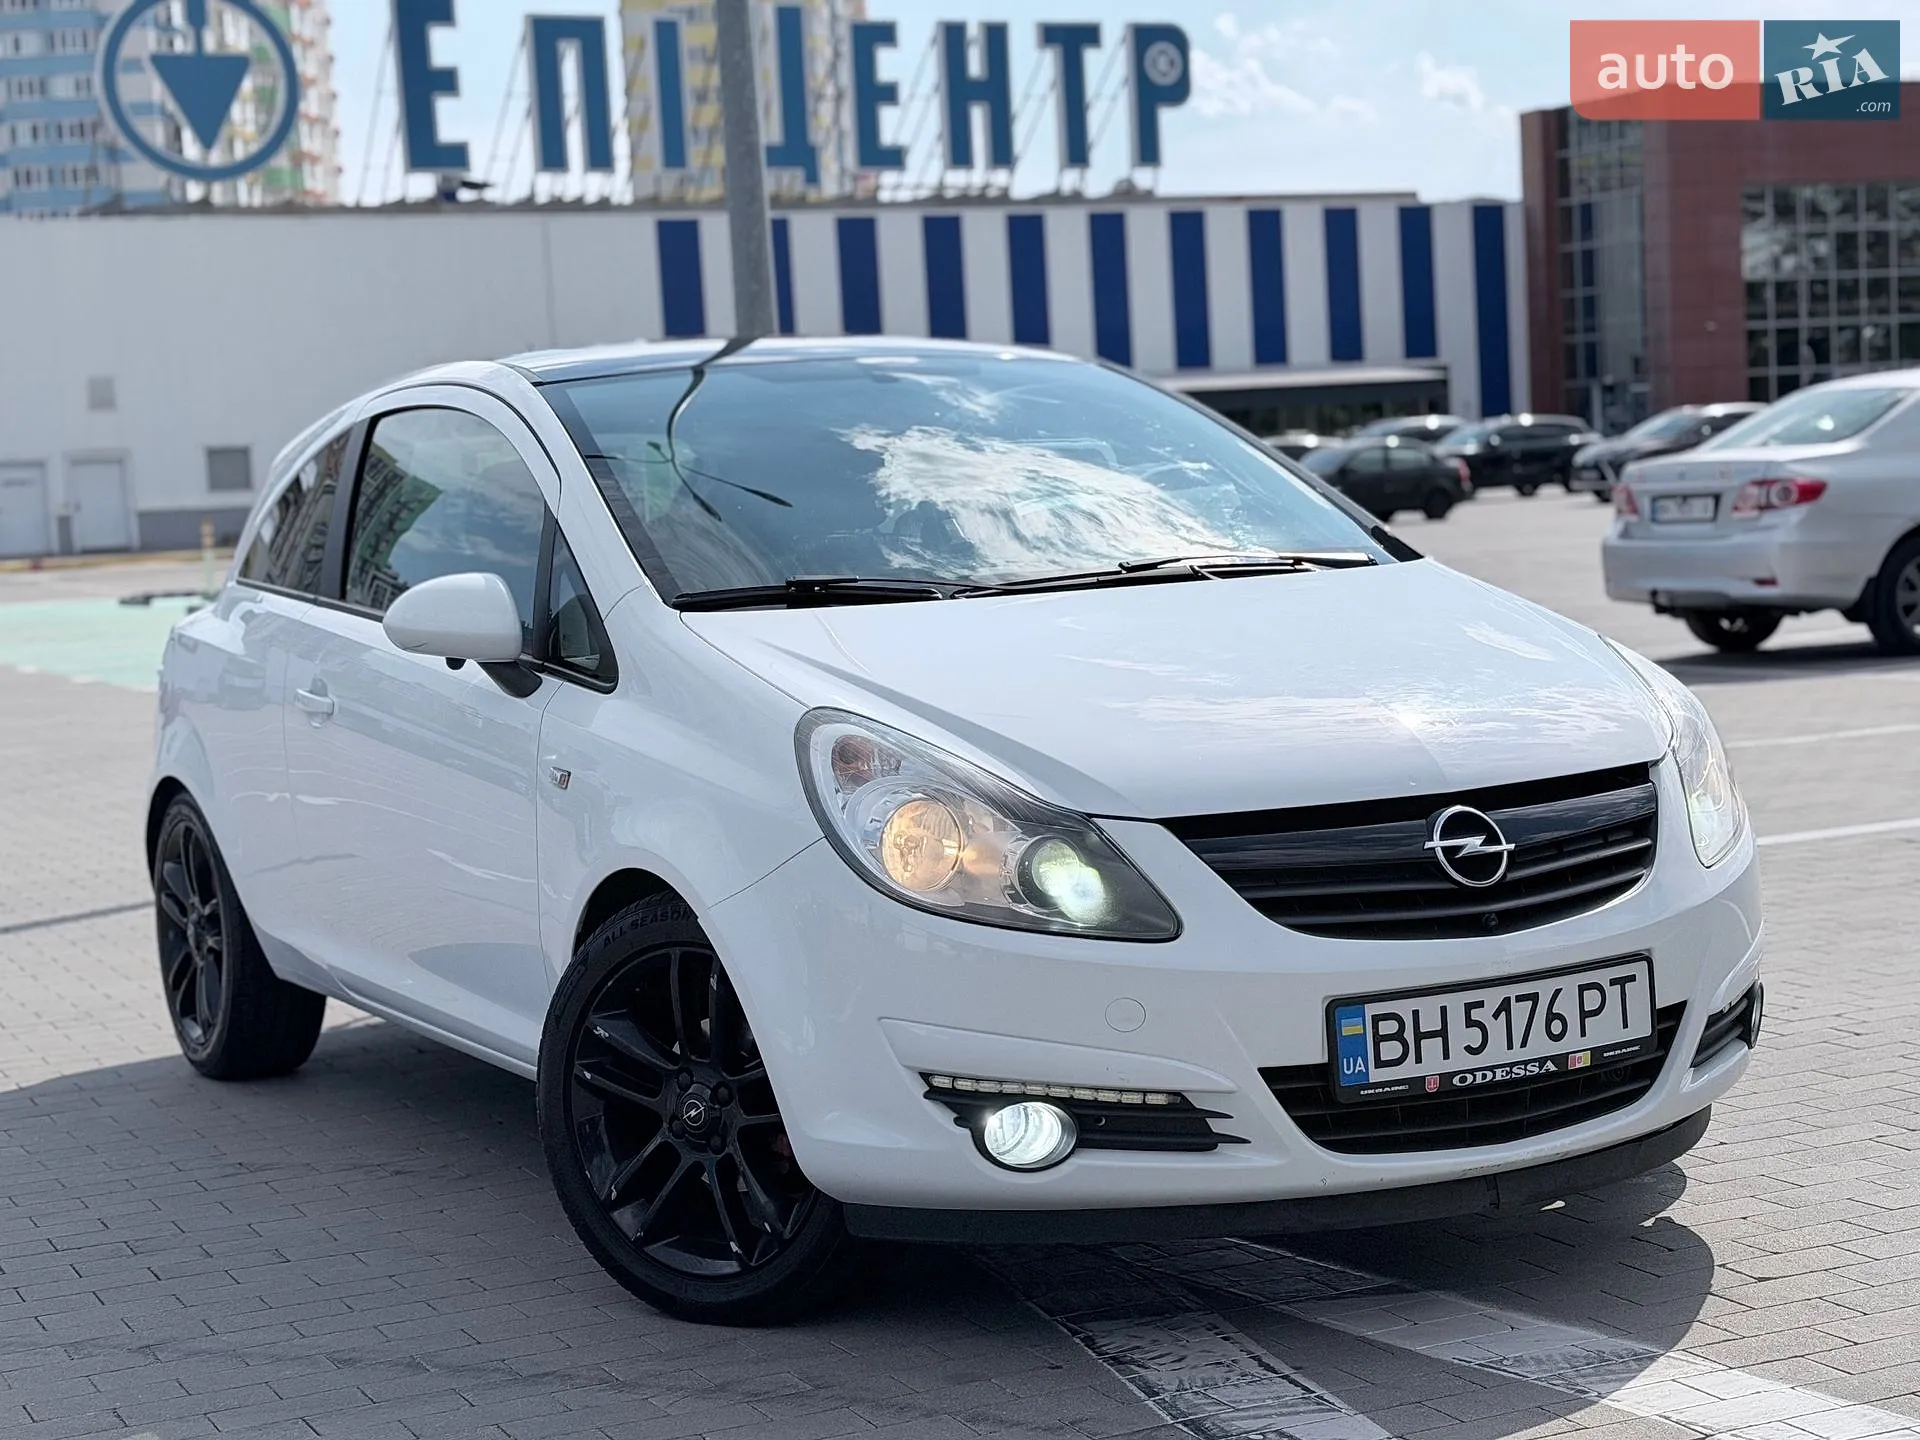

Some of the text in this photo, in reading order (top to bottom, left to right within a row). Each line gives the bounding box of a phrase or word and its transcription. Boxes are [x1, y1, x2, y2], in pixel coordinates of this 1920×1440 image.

[1371, 974, 1637, 1069] BH 5176 PT
[1343, 1057, 1366, 1075] UA
[1452, 1060, 1558, 1086] ODESSA
